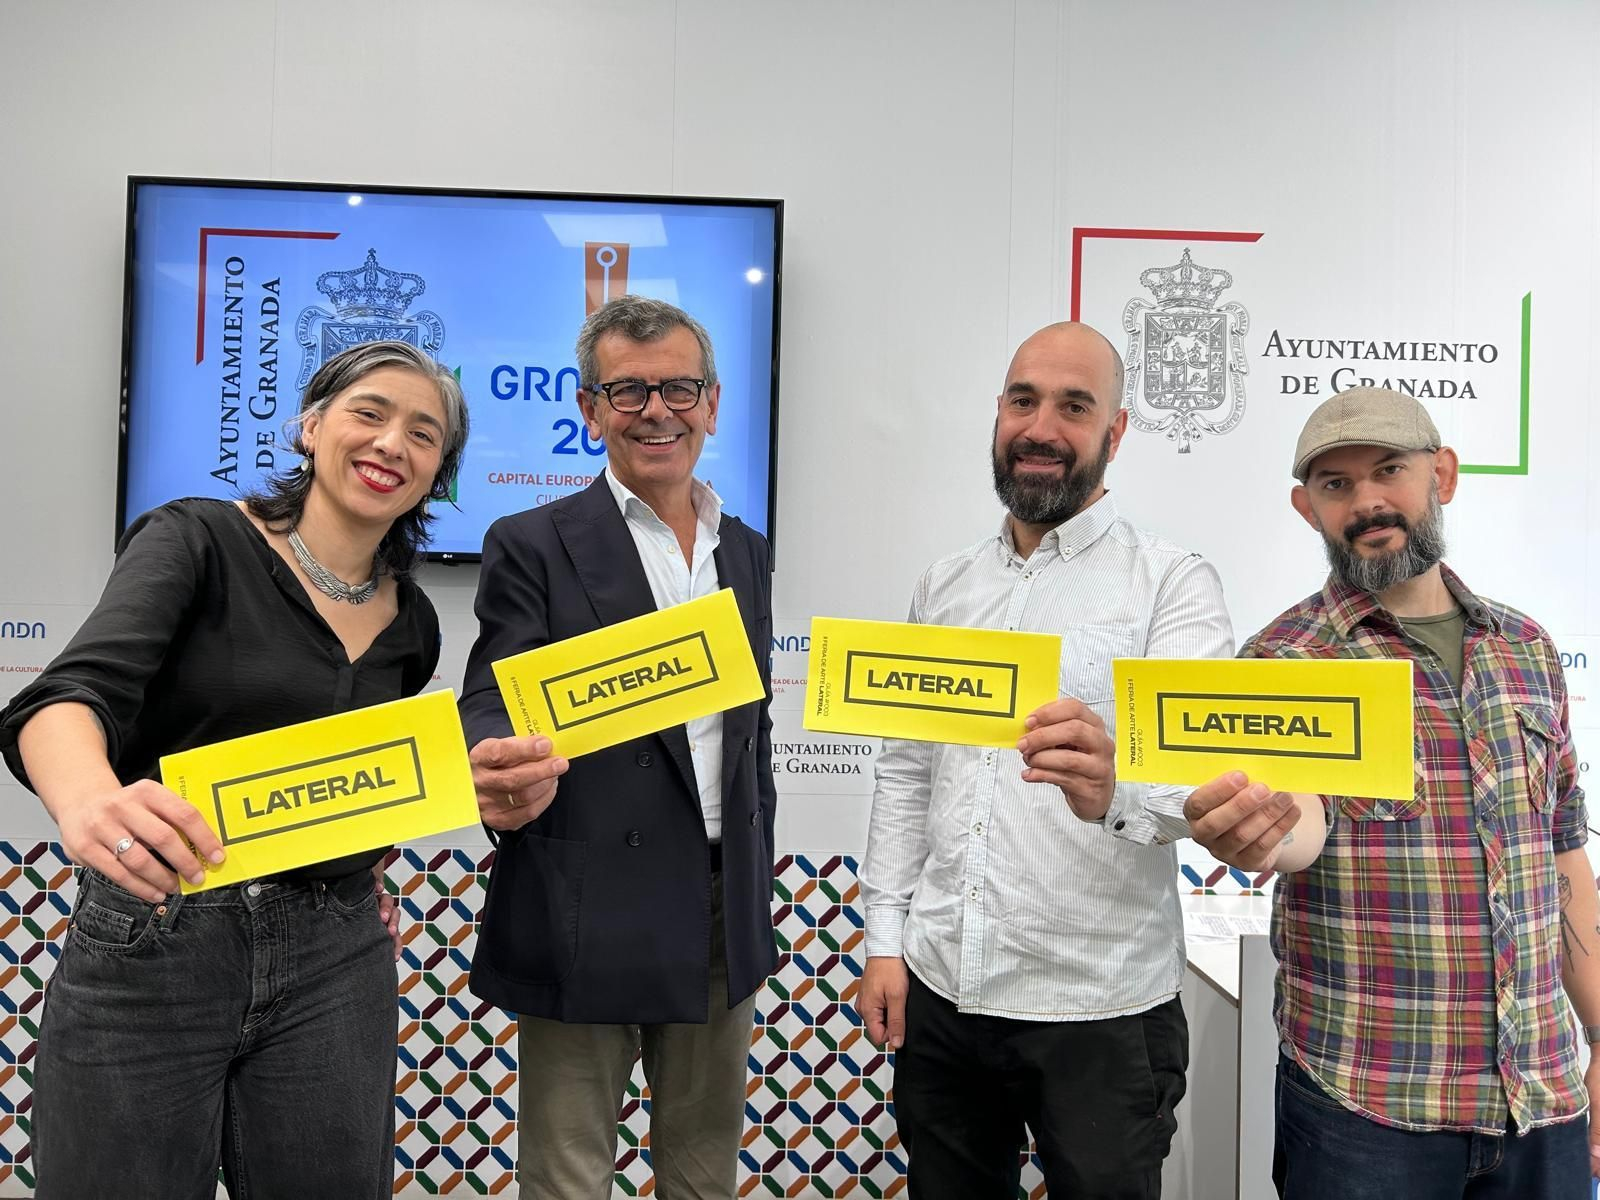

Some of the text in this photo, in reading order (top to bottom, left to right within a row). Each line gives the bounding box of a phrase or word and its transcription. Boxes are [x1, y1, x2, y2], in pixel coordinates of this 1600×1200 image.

[1262, 329, 1498, 363] AYUNTAMIENTO
[210, 256, 245, 486] AYUNTAMIENTO
[249, 277, 281, 469] DE GRANADA
[1280, 375, 1320, 395] DE
[488, 472, 597, 487] CAPITAL EUROP
[568, 657, 692, 708] LATERAL
[867, 669, 993, 699] LATERAL
[1127, 682, 1135, 702] FERIA
[816, 685, 824, 716] LATERAL
[1128, 702, 1135, 712] DE
[1183, 712, 1332, 738] LATERAL
[772, 743, 872, 756] UNTAMIENTO
[786, 758, 862, 774] GRANADA
[243, 766, 396, 819] LATERAL
